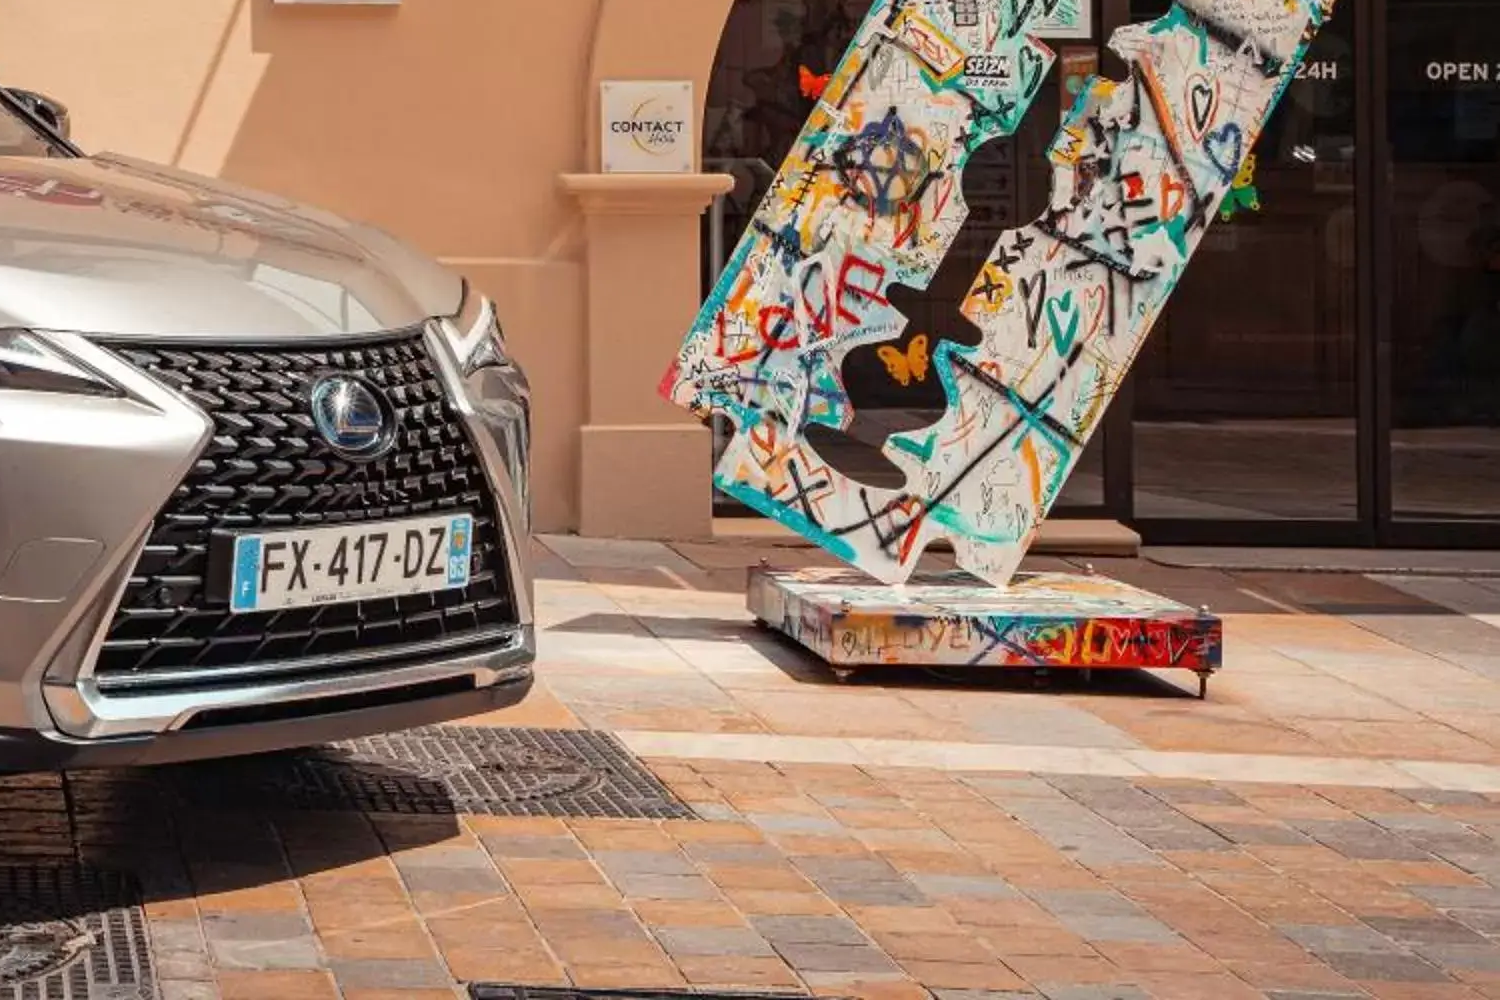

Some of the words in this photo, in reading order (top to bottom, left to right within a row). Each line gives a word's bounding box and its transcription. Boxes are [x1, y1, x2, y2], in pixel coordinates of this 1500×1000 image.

[1295, 62, 1337, 79] 24H
[1426, 62, 1489, 81] OPEN
[611, 121, 684, 133] CONTACT
[242, 580, 252, 598] F
